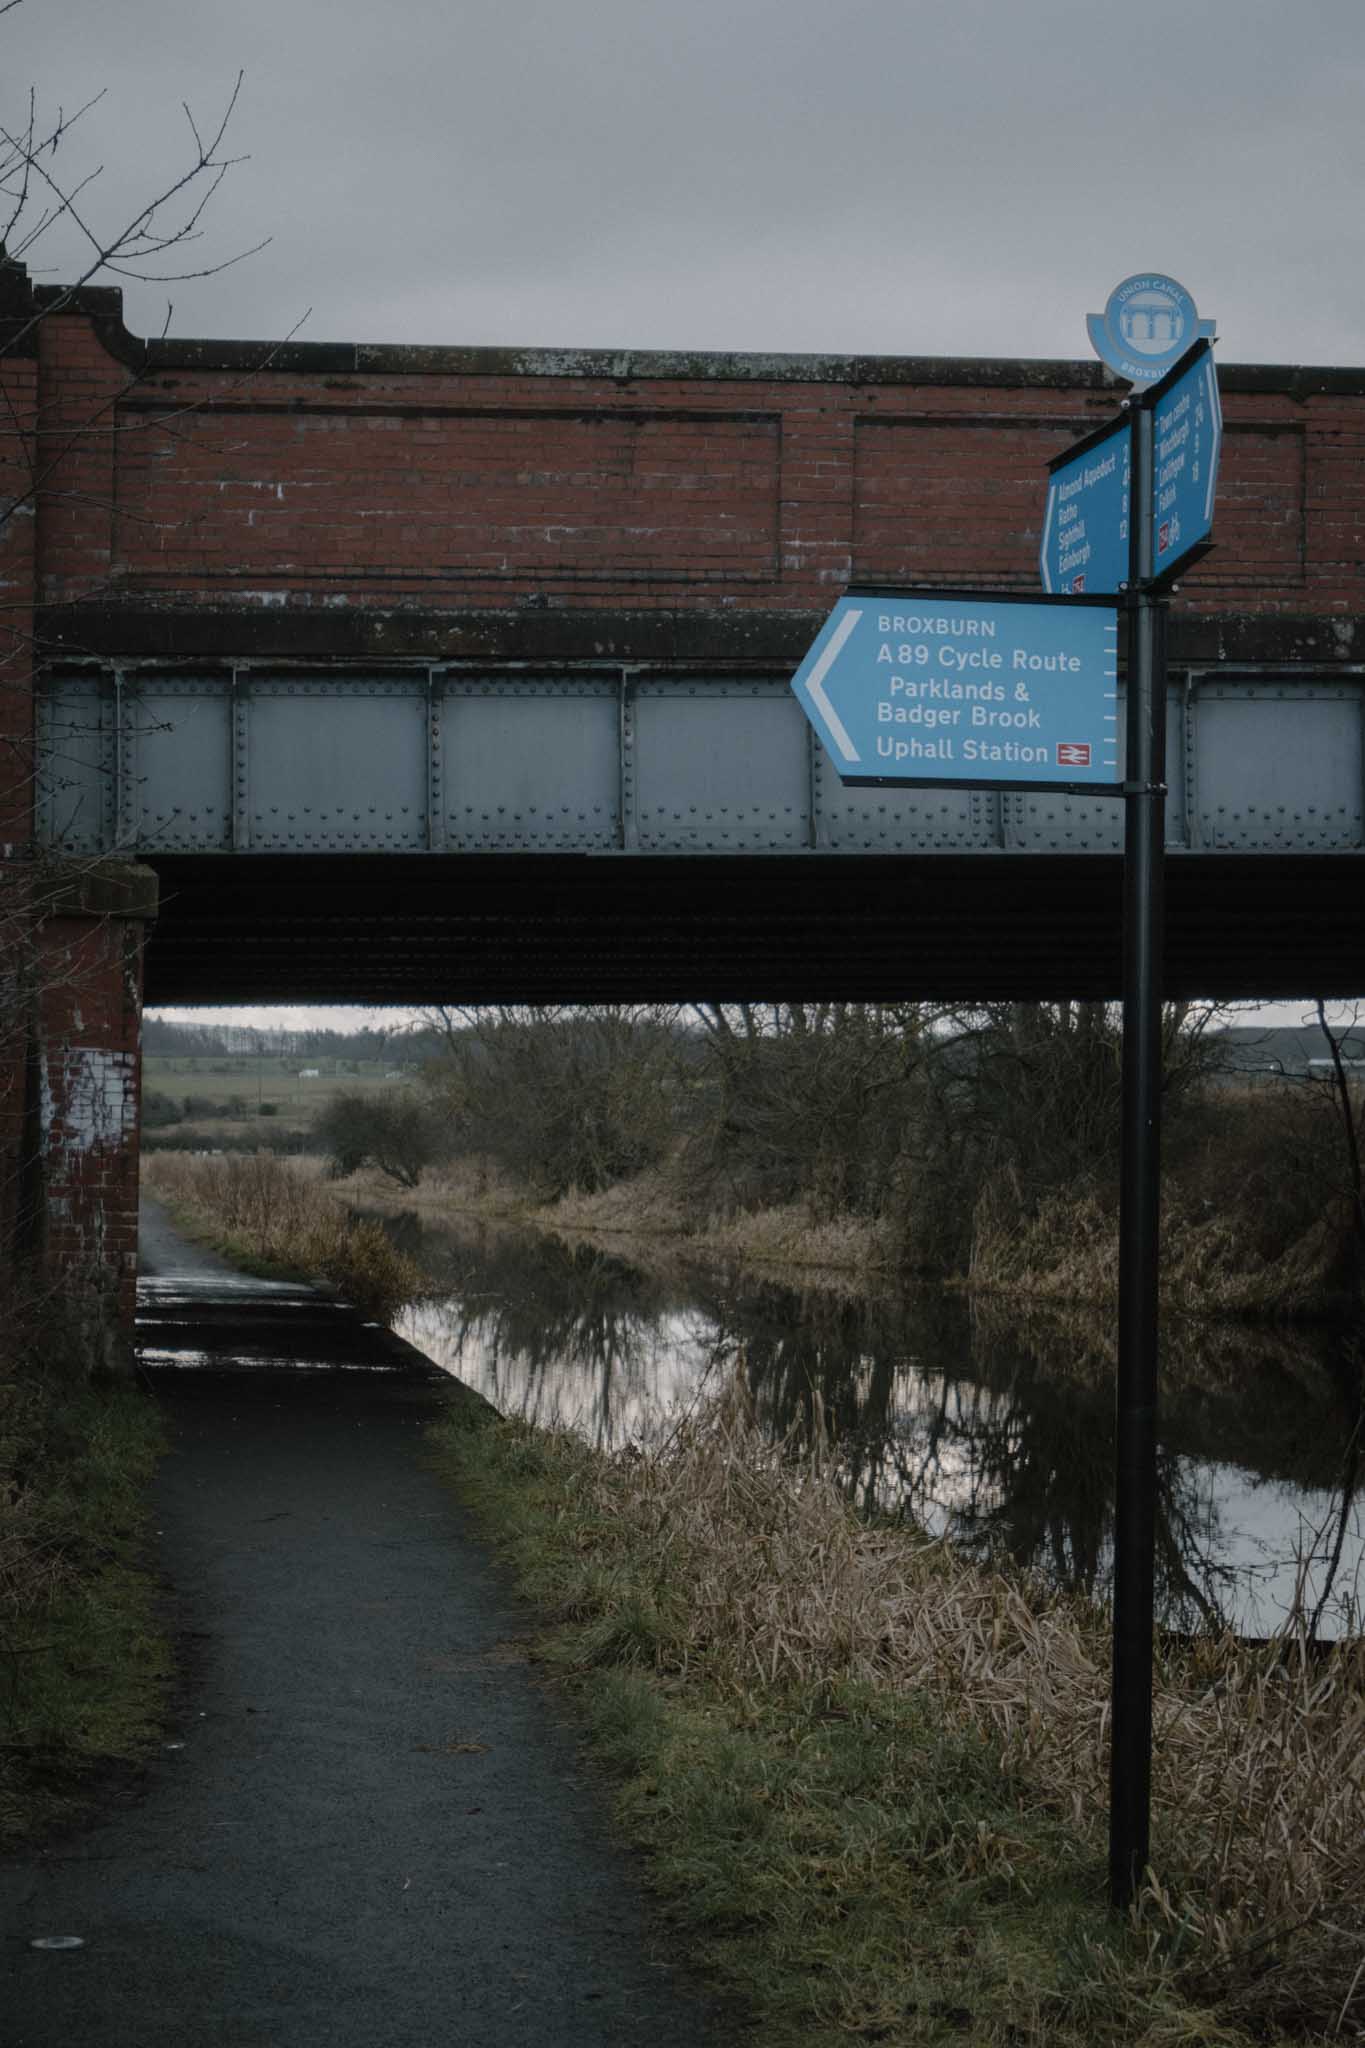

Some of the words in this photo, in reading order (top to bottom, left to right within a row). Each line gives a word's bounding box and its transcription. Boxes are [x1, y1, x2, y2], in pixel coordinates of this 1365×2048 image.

[1118, 280, 1150, 303] UNION
[1152, 280, 1185, 304] CANAL
[1120, 361, 1171, 379] BROXBU
[1059, 471, 1083, 501] Almond
[1083, 453, 1116, 488] Aqueduct
[1160, 482, 1177, 514] Falkirk
[1059, 503, 1079, 524] Ratho
[1059, 519, 1085, 549] Sighthill
[1059, 543, 1090, 573] Edinburgh
[877, 615, 996, 637] BROXBURN
[876, 643, 930, 665] A89
[938, 646, 1003, 672] Cycle
[1012, 649, 1082, 673] Route
[890, 676, 1005, 702] Parklands
[1014, 682, 1031, 702] &
[877, 702, 961, 728] Badger
[971, 706, 1041, 729] Brook
[876, 735, 954, 761] Uphall
[962, 739, 1049, 763] Station
